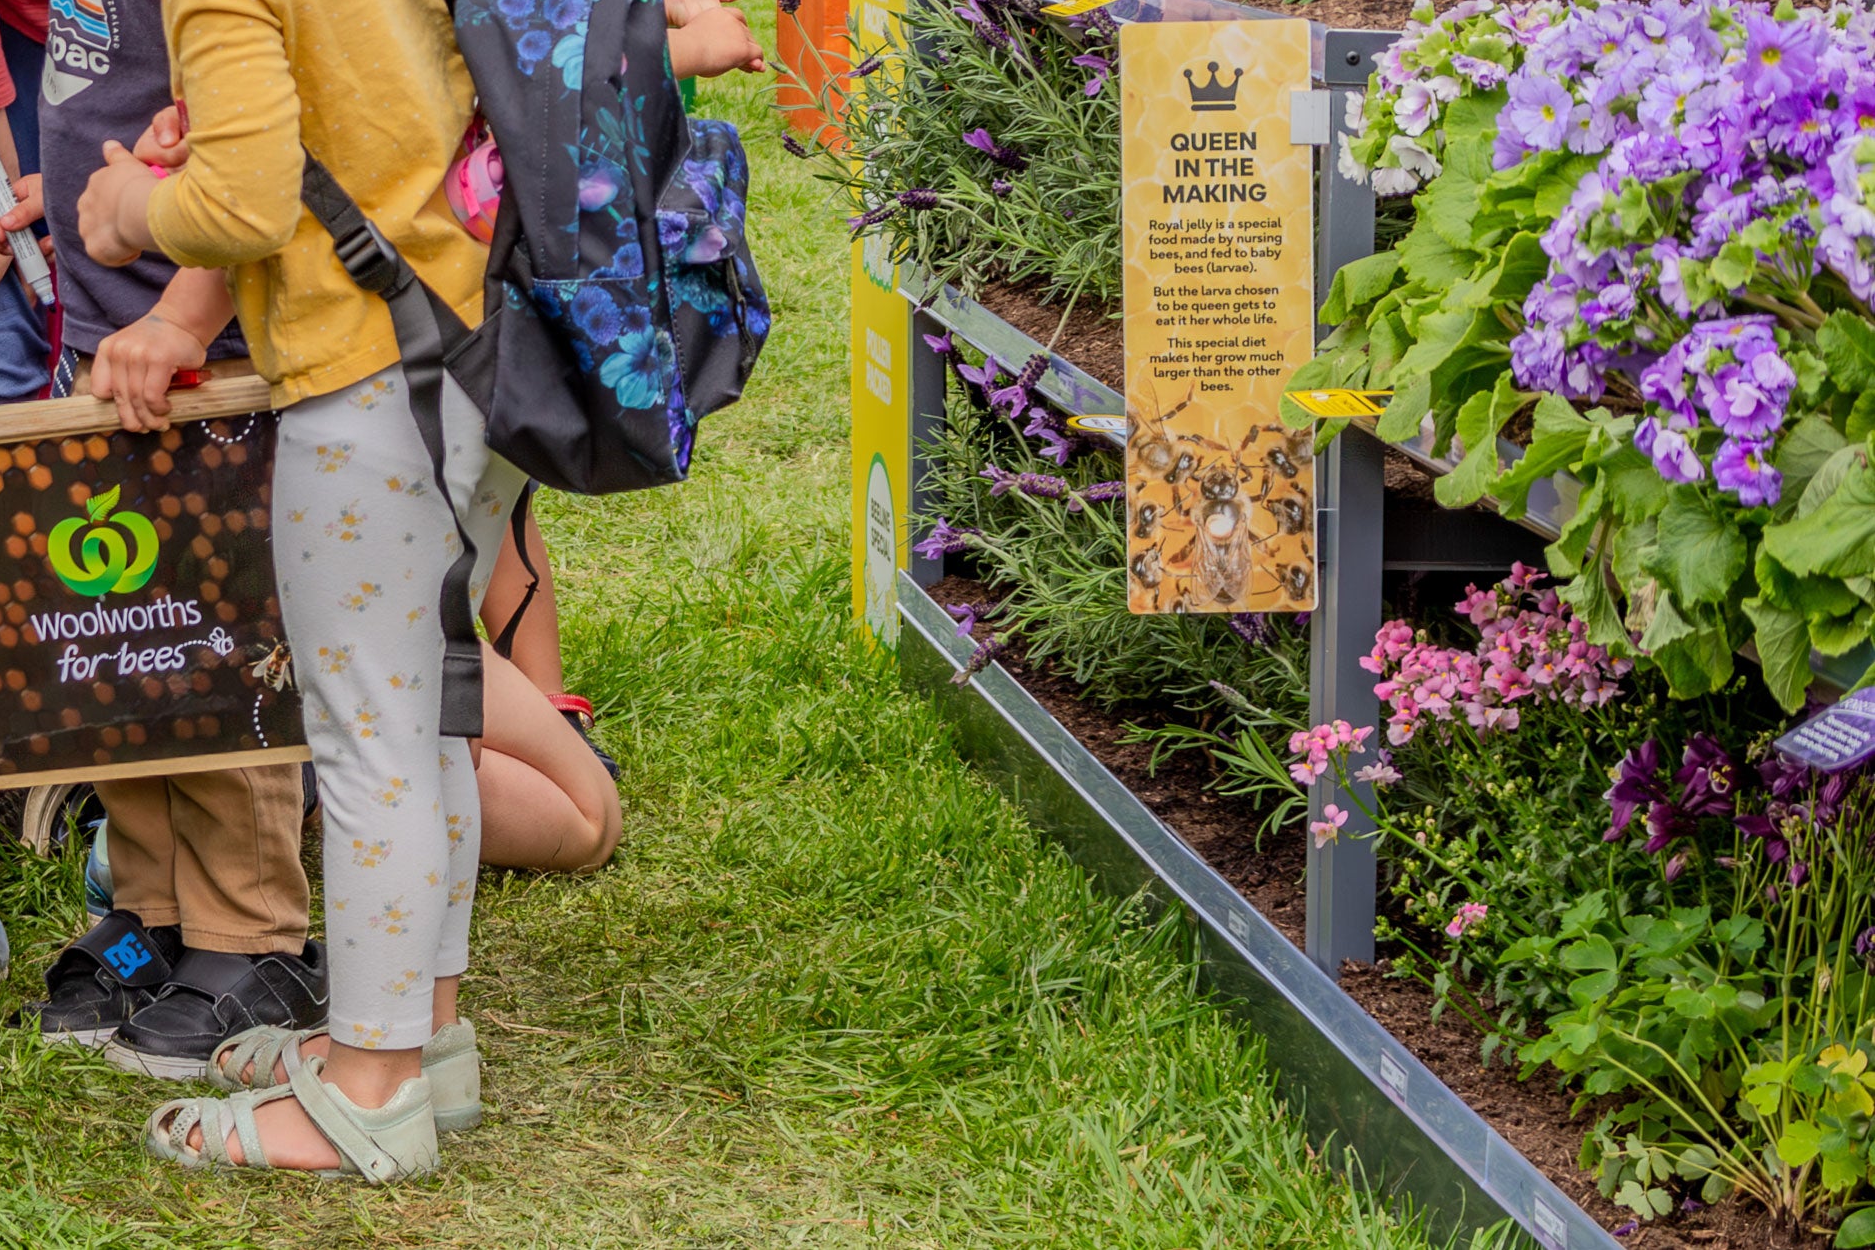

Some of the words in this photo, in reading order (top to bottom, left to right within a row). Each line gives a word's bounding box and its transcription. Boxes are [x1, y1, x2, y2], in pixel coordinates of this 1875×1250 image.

[106, 0, 122, 50] ZEALAND
[1170, 132, 1257, 151] QUEEN
[1176, 159, 1199, 177] IN
[1205, 158, 1254, 177] THE
[1163, 183, 1267, 203] MAKING
[1149, 220, 1183, 232] Royal
[1186, 220, 1212, 233] jelly
[1216, 219, 1224, 229] is
[1228, 221, 1235, 229] a
[1238, 218, 1282, 232] special
[1149, 234, 1177, 245] food
[1181, 234, 1215, 244] made
[1219, 233, 1233, 246] by
[1237, 233, 1282, 245] nursing
[1150, 249, 1182, 260] bees,
[1185, 248, 1207, 259] and
[1211, 248, 1231, 258] fed
[1235, 248, 1247, 258] to
[1251, 247, 1281, 261] baby
[1175, 263, 1203, 274] bees
[1207, 262, 1257, 274] (larvae).
[1154, 287, 1174, 297] But
[1178, 286, 1198, 296] the
[1201, 286, 1231, 296] larva
[1235, 285, 1279, 295] chosen
[1157, 301, 1169, 311] to
[1173, 301, 1188, 310] be
[1192, 301, 1230, 315] queen
[1233, 300, 1259, 313] gets
[1263, 300, 1275, 310] to
[1156, 315, 1176, 326] eat
[1179, 315, 1186, 325] it
[1190, 314, 1209, 325] her
[1213, 314, 1250, 325] whole
[1253, 314, 1277, 324] life.
[866, 326, 892, 373] POLLEN
[1167, 338, 1192, 348] This
[1196, 337, 1239, 351] special
[1242, 337, 1266, 347] diet
[1150, 352, 1189, 363] makes
[1193, 352, 1212, 362] her
[1215, 352, 1246, 366] grow
[1250, 351, 1284, 361] much
[1154, 367, 1190, 380] larger
[1193, 367, 1220, 377] than
[1224, 366, 1244, 376] the
[1248, 366, 1281, 376] other
[866, 359, 892, 406] PACKED
[1201, 381, 1234, 391] bees.
[31, 594, 202, 643] Woolworths
[57, 644, 109, 683] for
[117, 641, 186, 677] bees
